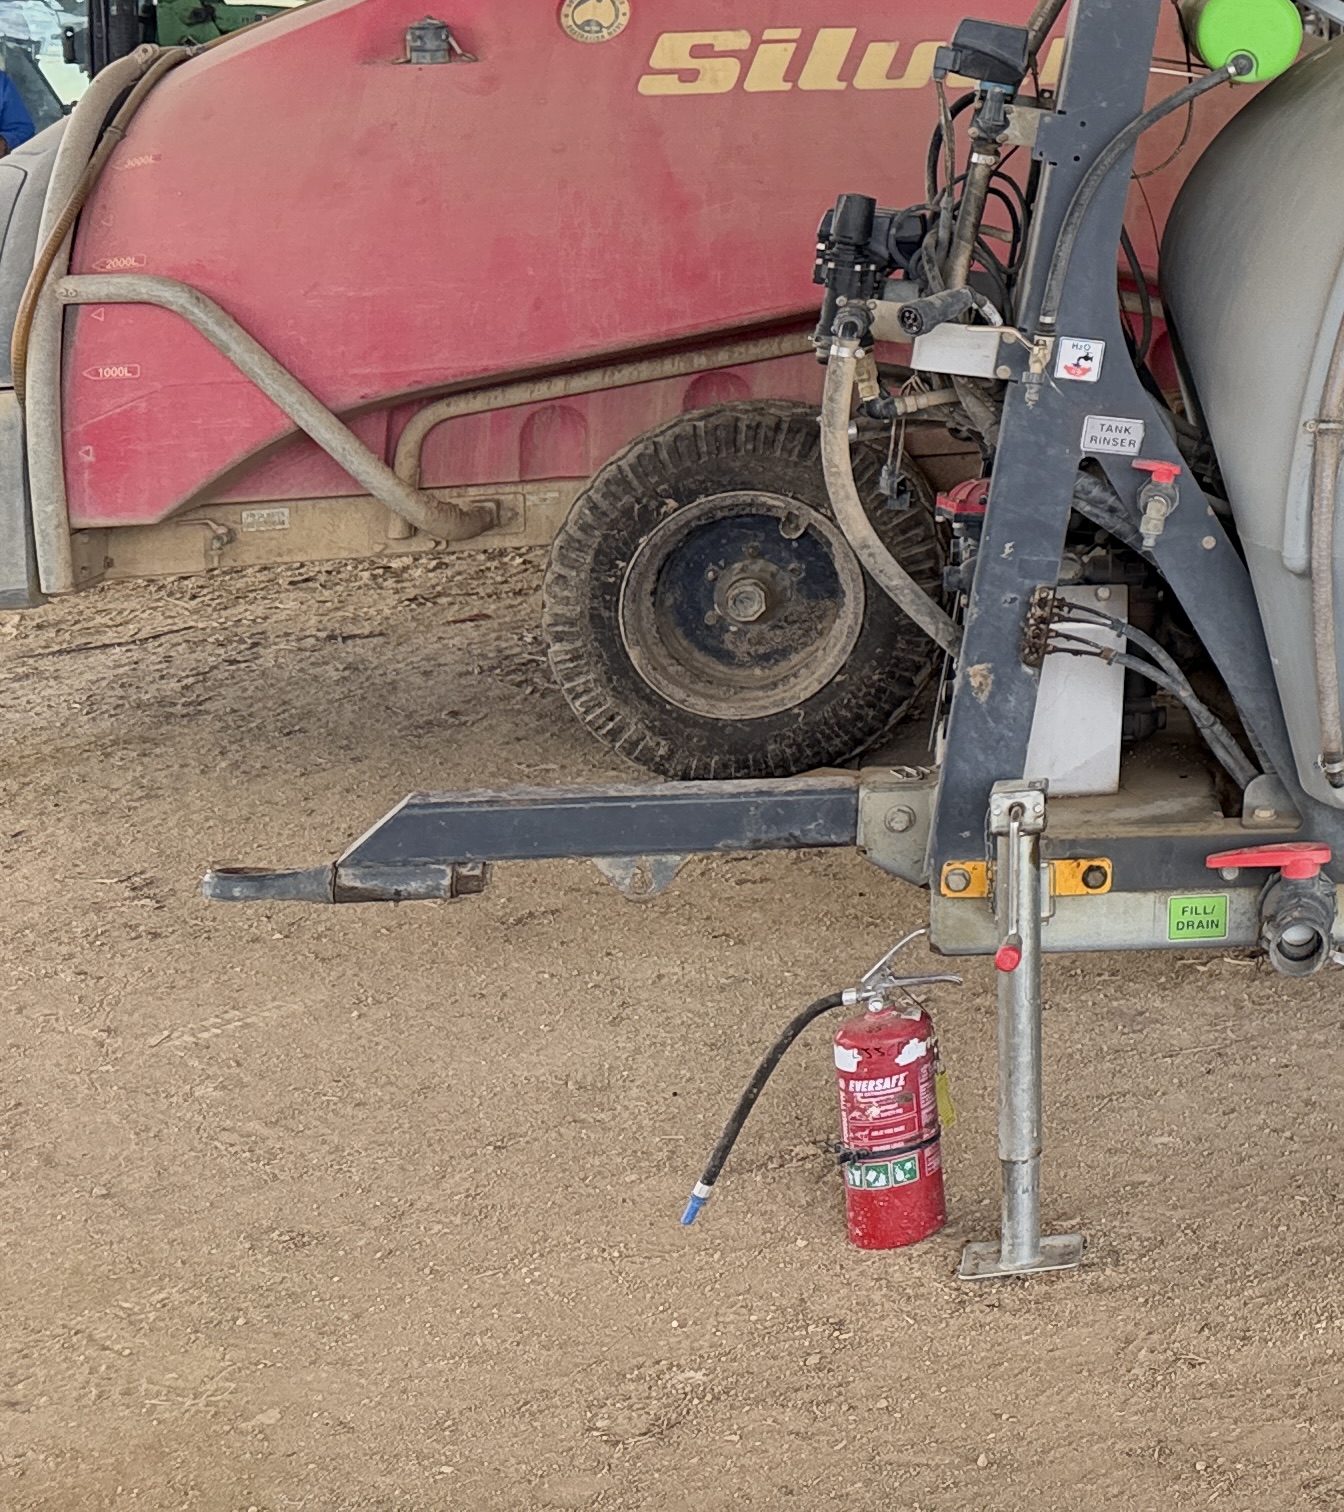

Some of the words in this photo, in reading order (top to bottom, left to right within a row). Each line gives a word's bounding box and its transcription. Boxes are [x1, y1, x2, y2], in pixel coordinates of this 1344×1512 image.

[105, 256, 139, 269] 2000L
[98, 367, 132, 377] 1000L
[1099, 423, 1133, 435] TANK
[1090, 435, 1137, 448] RINSER
[1181, 904, 1216, 916] FILL/
[1176, 919, 1220, 931] DRAIN
[848, 1071, 909, 1092] EVERSAFE
